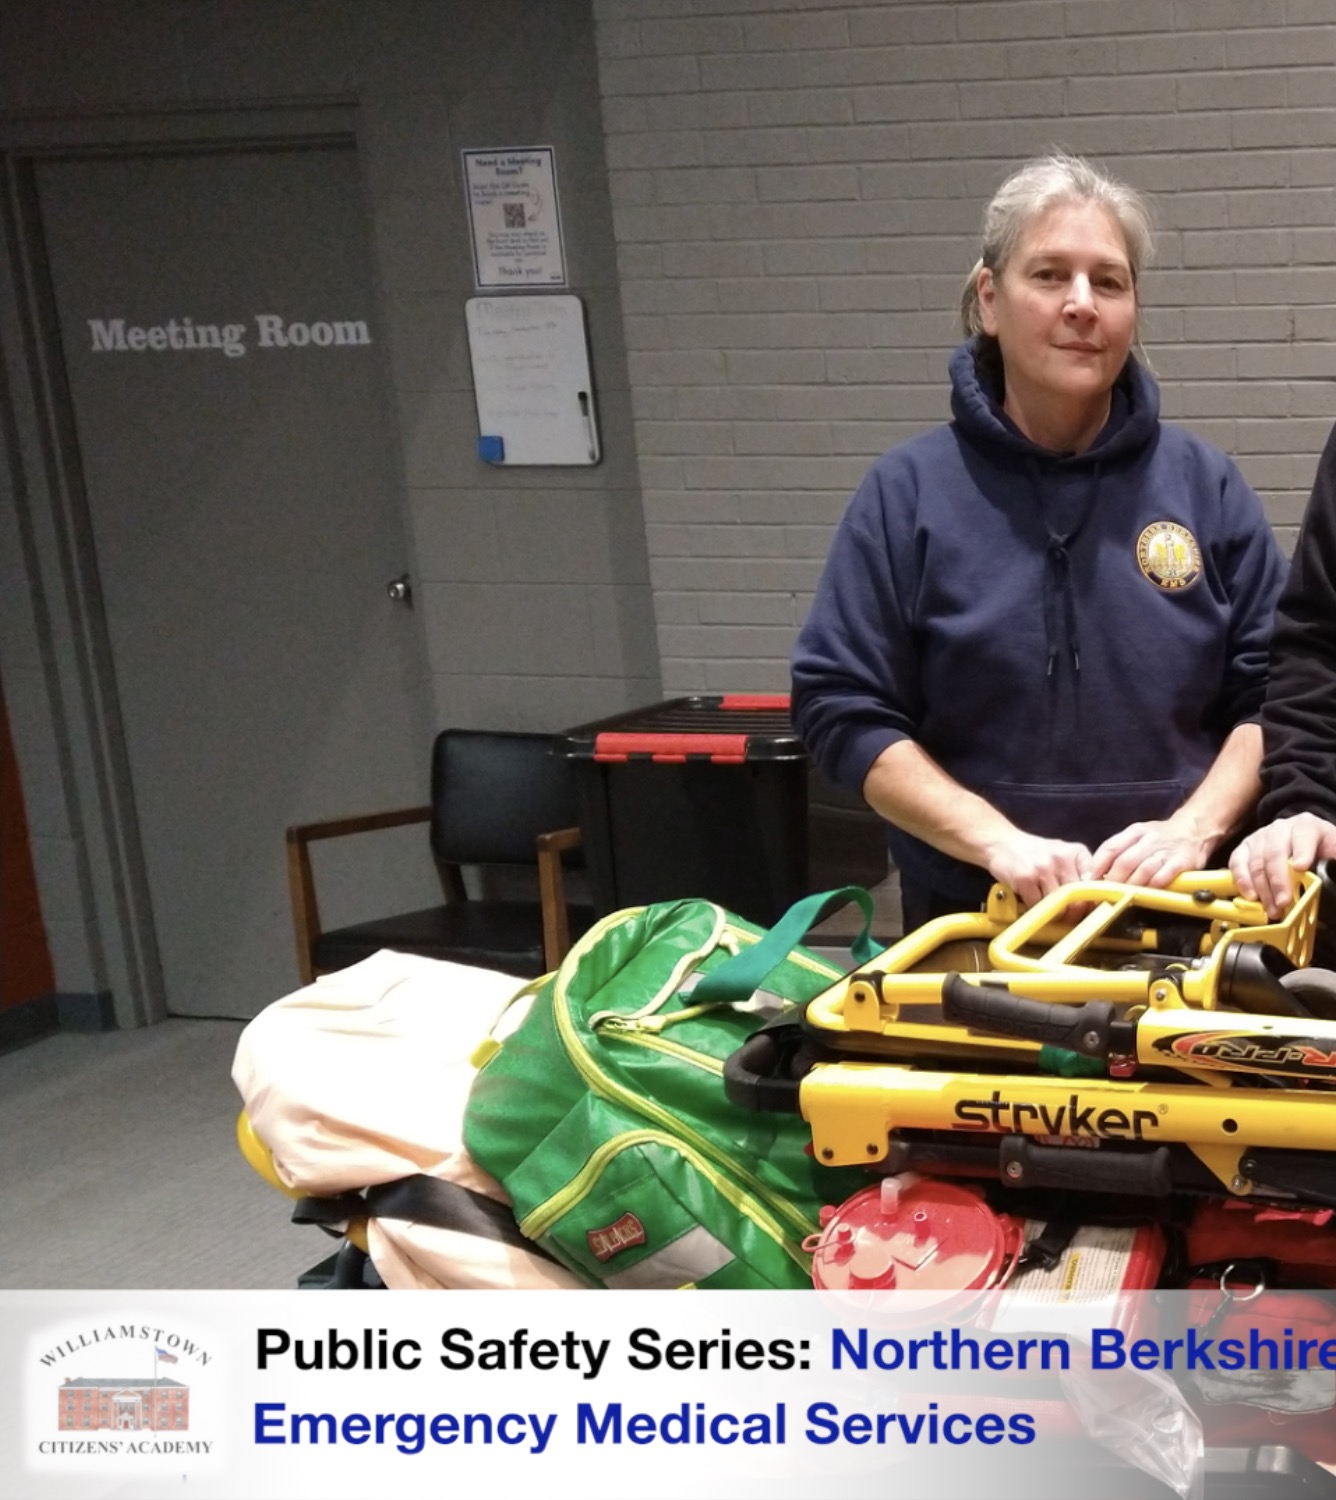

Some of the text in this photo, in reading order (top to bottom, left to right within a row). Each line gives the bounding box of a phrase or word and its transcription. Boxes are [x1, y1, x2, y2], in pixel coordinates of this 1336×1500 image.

[87, 315, 371, 357] Meeting Room
[952, 1090, 1159, 1141] stryker
